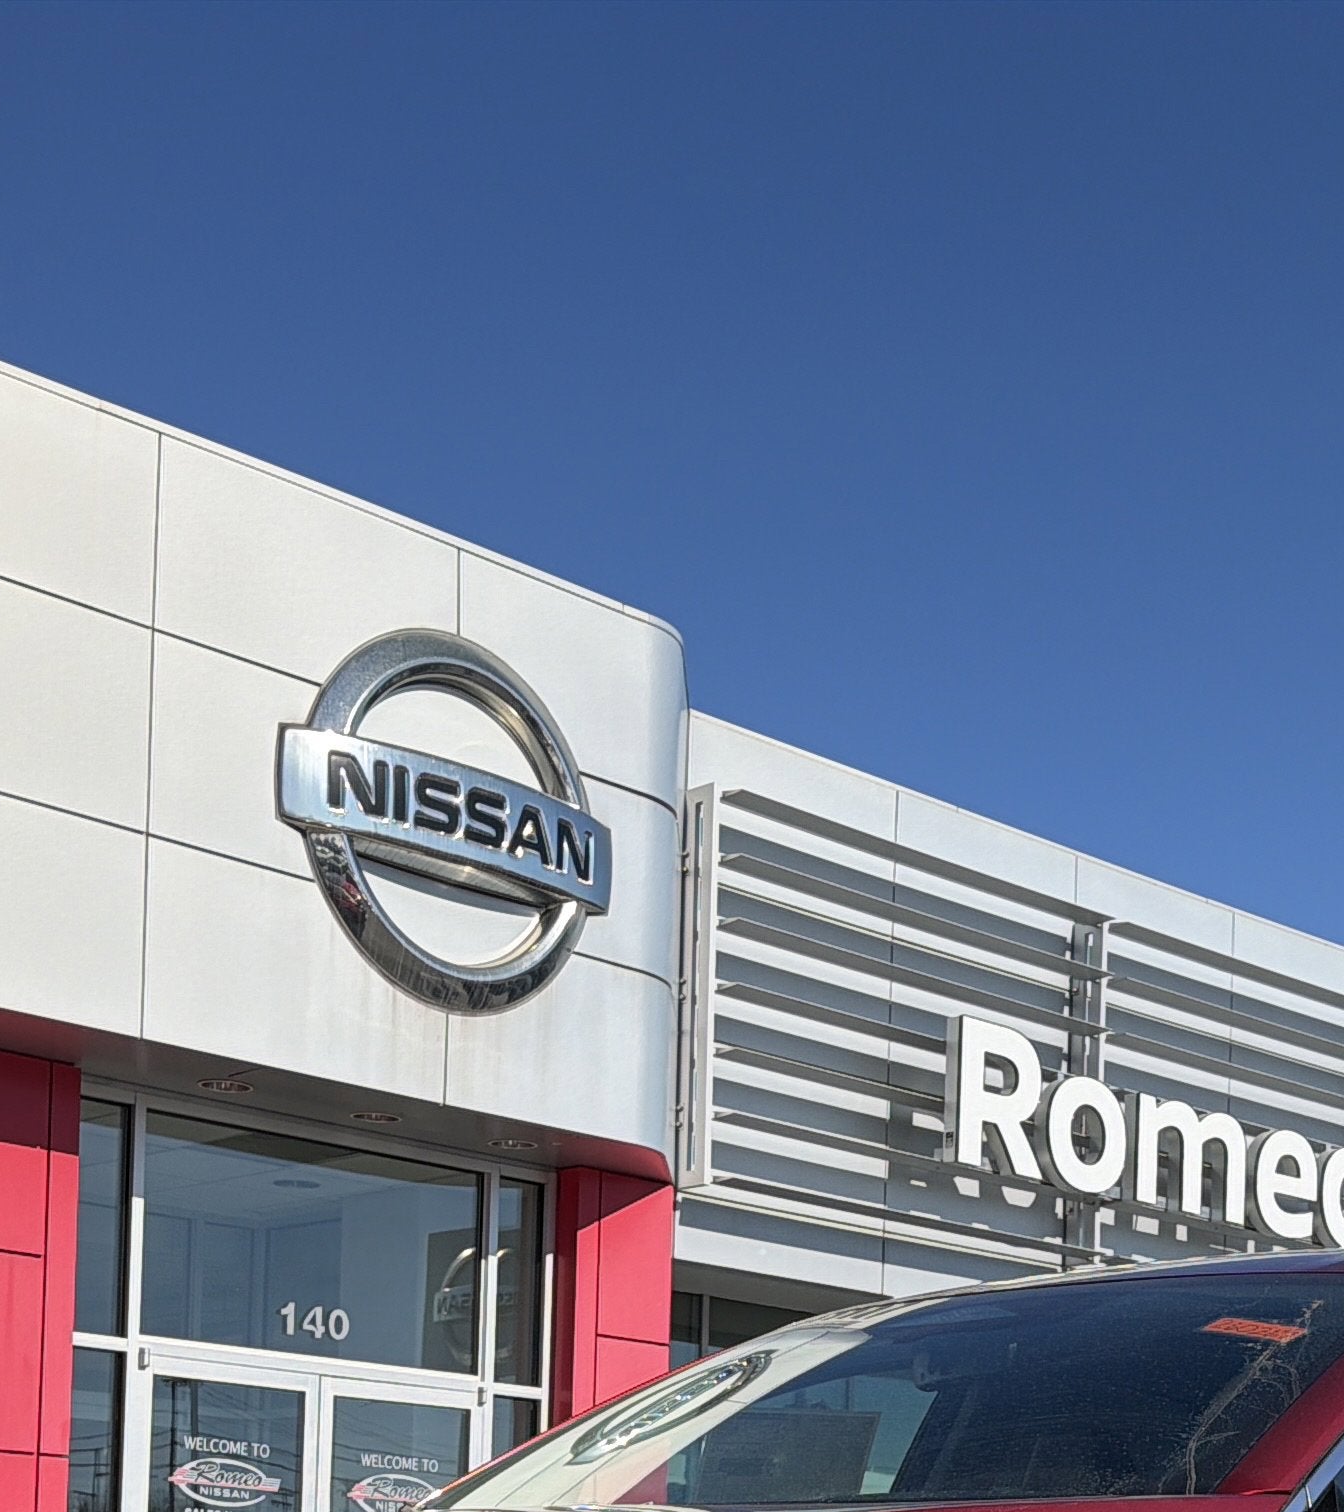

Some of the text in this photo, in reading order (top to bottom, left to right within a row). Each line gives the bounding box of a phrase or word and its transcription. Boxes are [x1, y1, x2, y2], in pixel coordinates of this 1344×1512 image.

[325, 748, 595, 887] NISSAN
[279, 1301, 350, 1341] 140
[183, 1435, 270, 1459] WELCOME TO
[190, 1460, 264, 1488] Romeo
[360, 1452, 439, 1473] WELCOME TO
[199, 1487, 250, 1500] NISSAN
